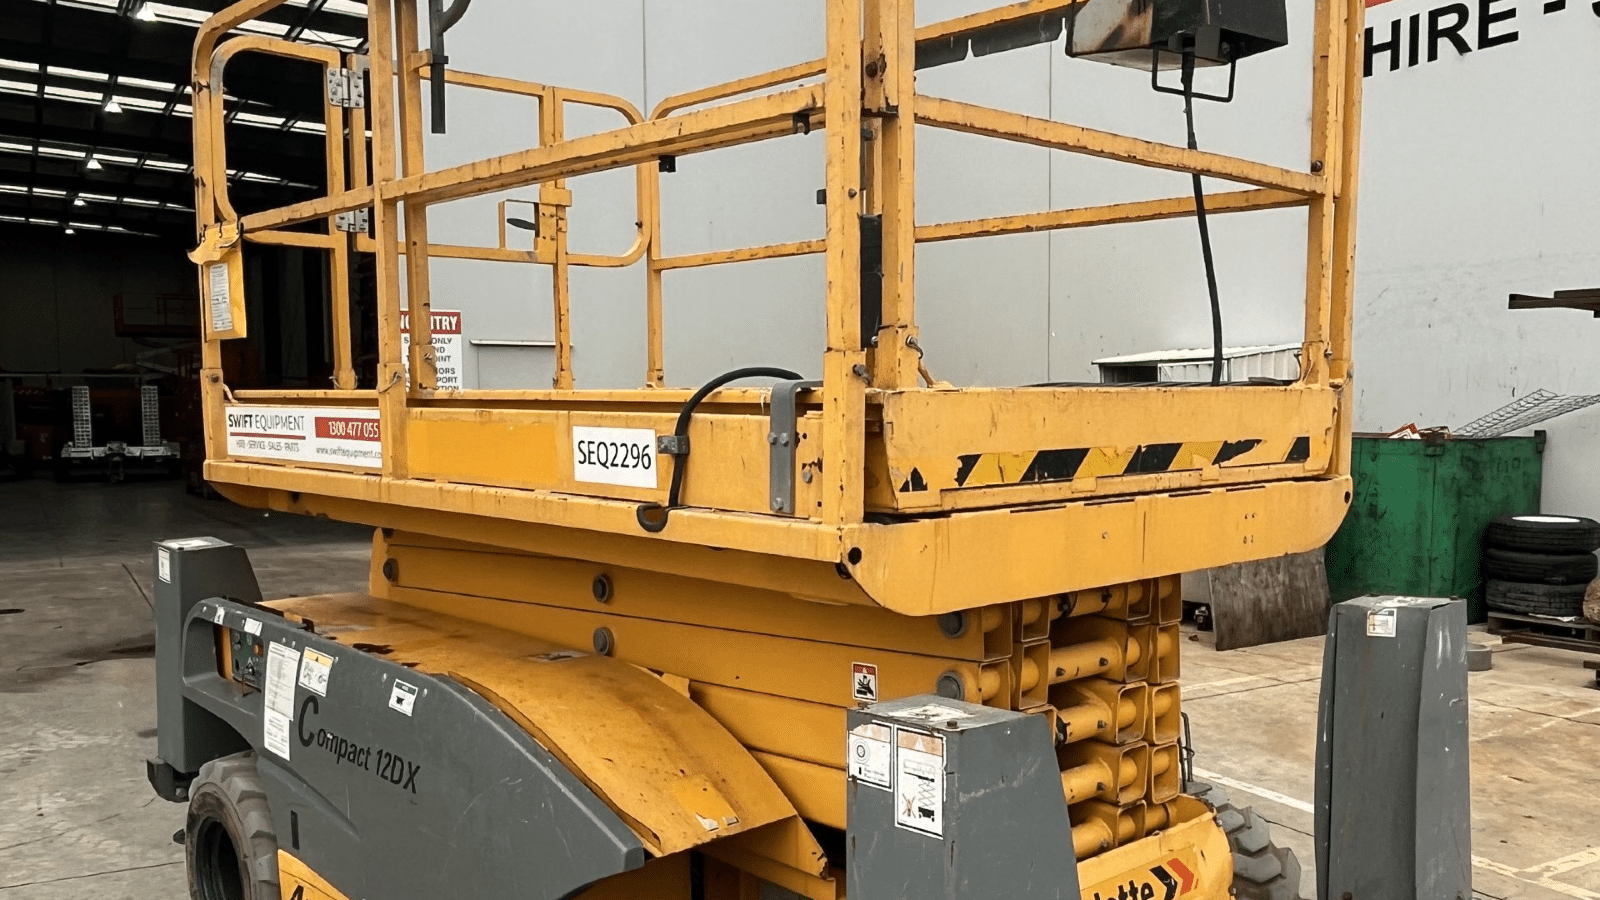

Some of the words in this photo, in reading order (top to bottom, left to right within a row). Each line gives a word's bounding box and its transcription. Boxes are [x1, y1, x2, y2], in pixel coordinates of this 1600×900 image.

[1363, 0, 1519, 78] HIRE
[228, 413, 254, 428] SWIFT
[255, 414, 305, 431] EQUIPMENT
[328, 420, 346, 436] 1300
[346, 421, 362, 437] 477
[363, 422, 379, 438] 055
[577, 440, 652, 470] SEQ2296
[298, 695, 370, 771] Compact
[376, 749, 421, 794] 12DX
